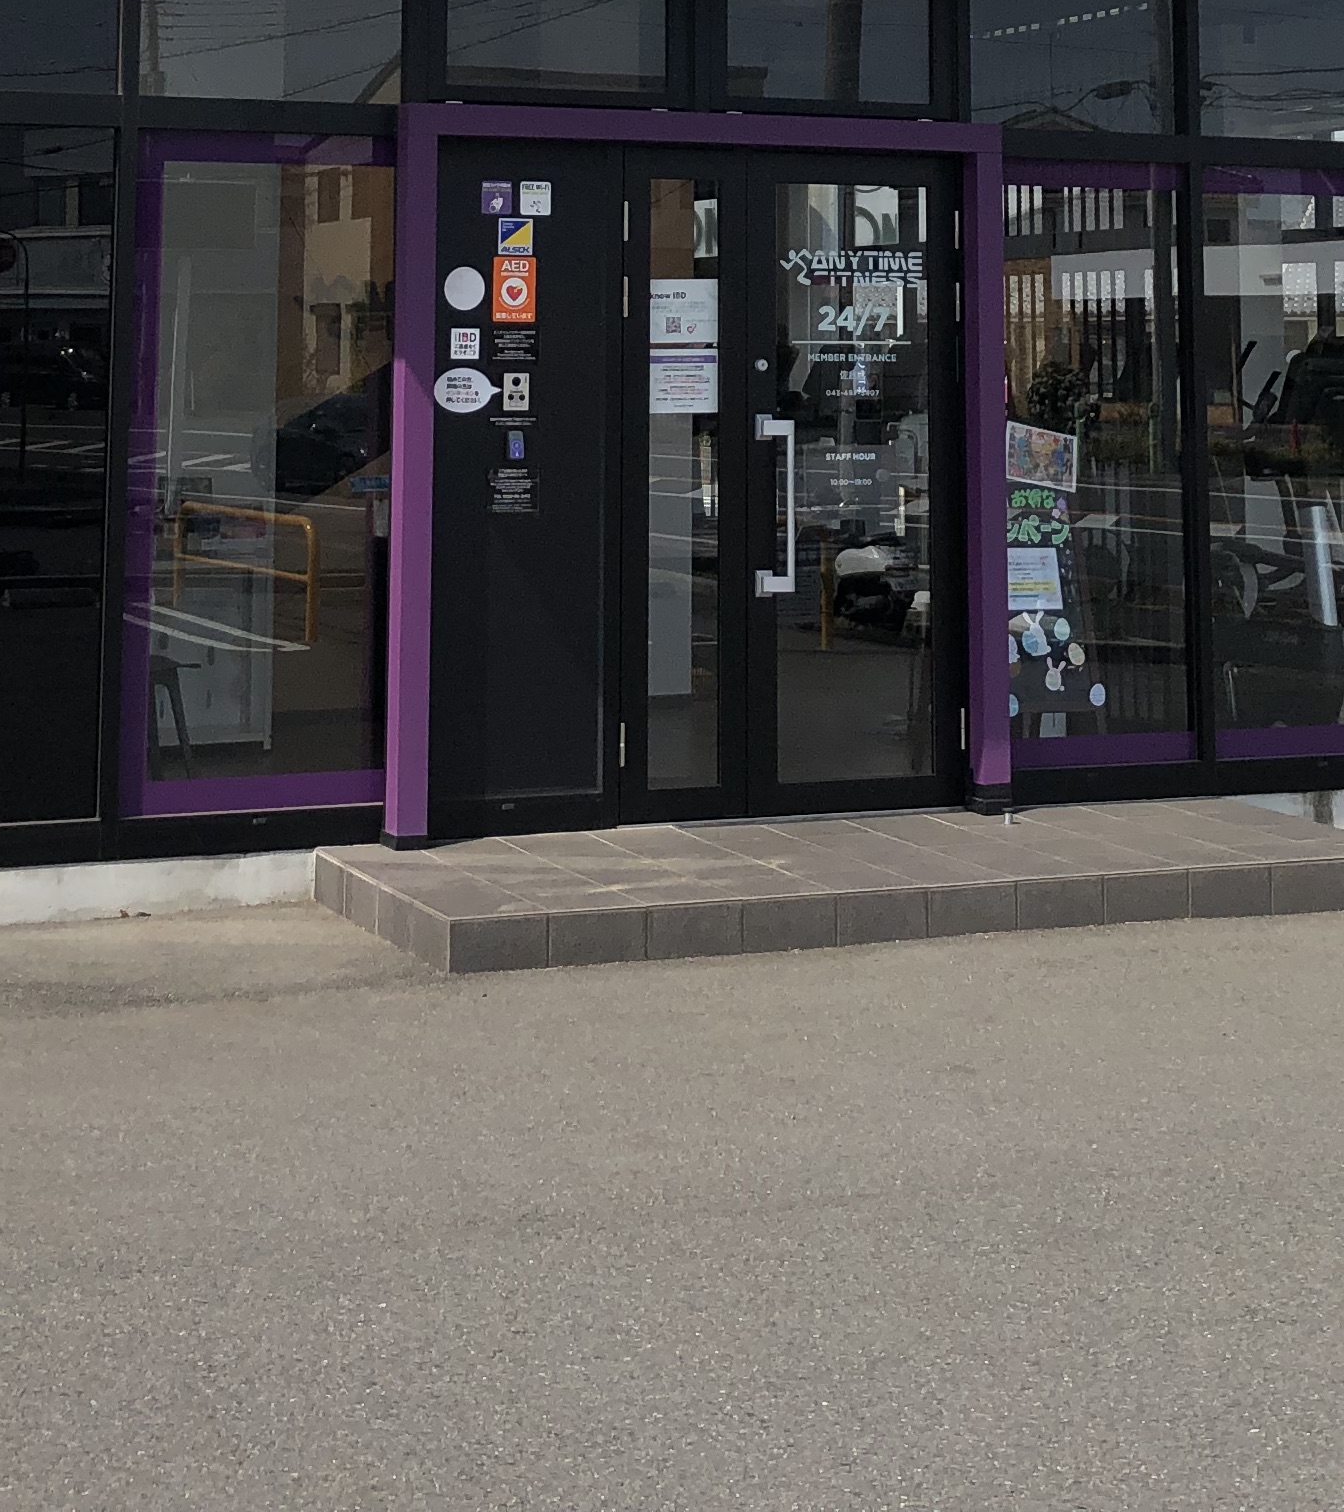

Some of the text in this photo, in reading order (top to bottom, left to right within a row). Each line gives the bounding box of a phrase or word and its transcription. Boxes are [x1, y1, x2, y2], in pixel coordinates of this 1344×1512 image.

[500, 246, 531, 254] ALSOK
[811, 250, 923, 271] ANYTIME
[501, 260, 529, 272] AED
[817, 303, 890, 336] 24/7
[808, 354, 897, 362] MEMBER ENTRANCE
[825, 453, 876, 461] STAFF HOUR
